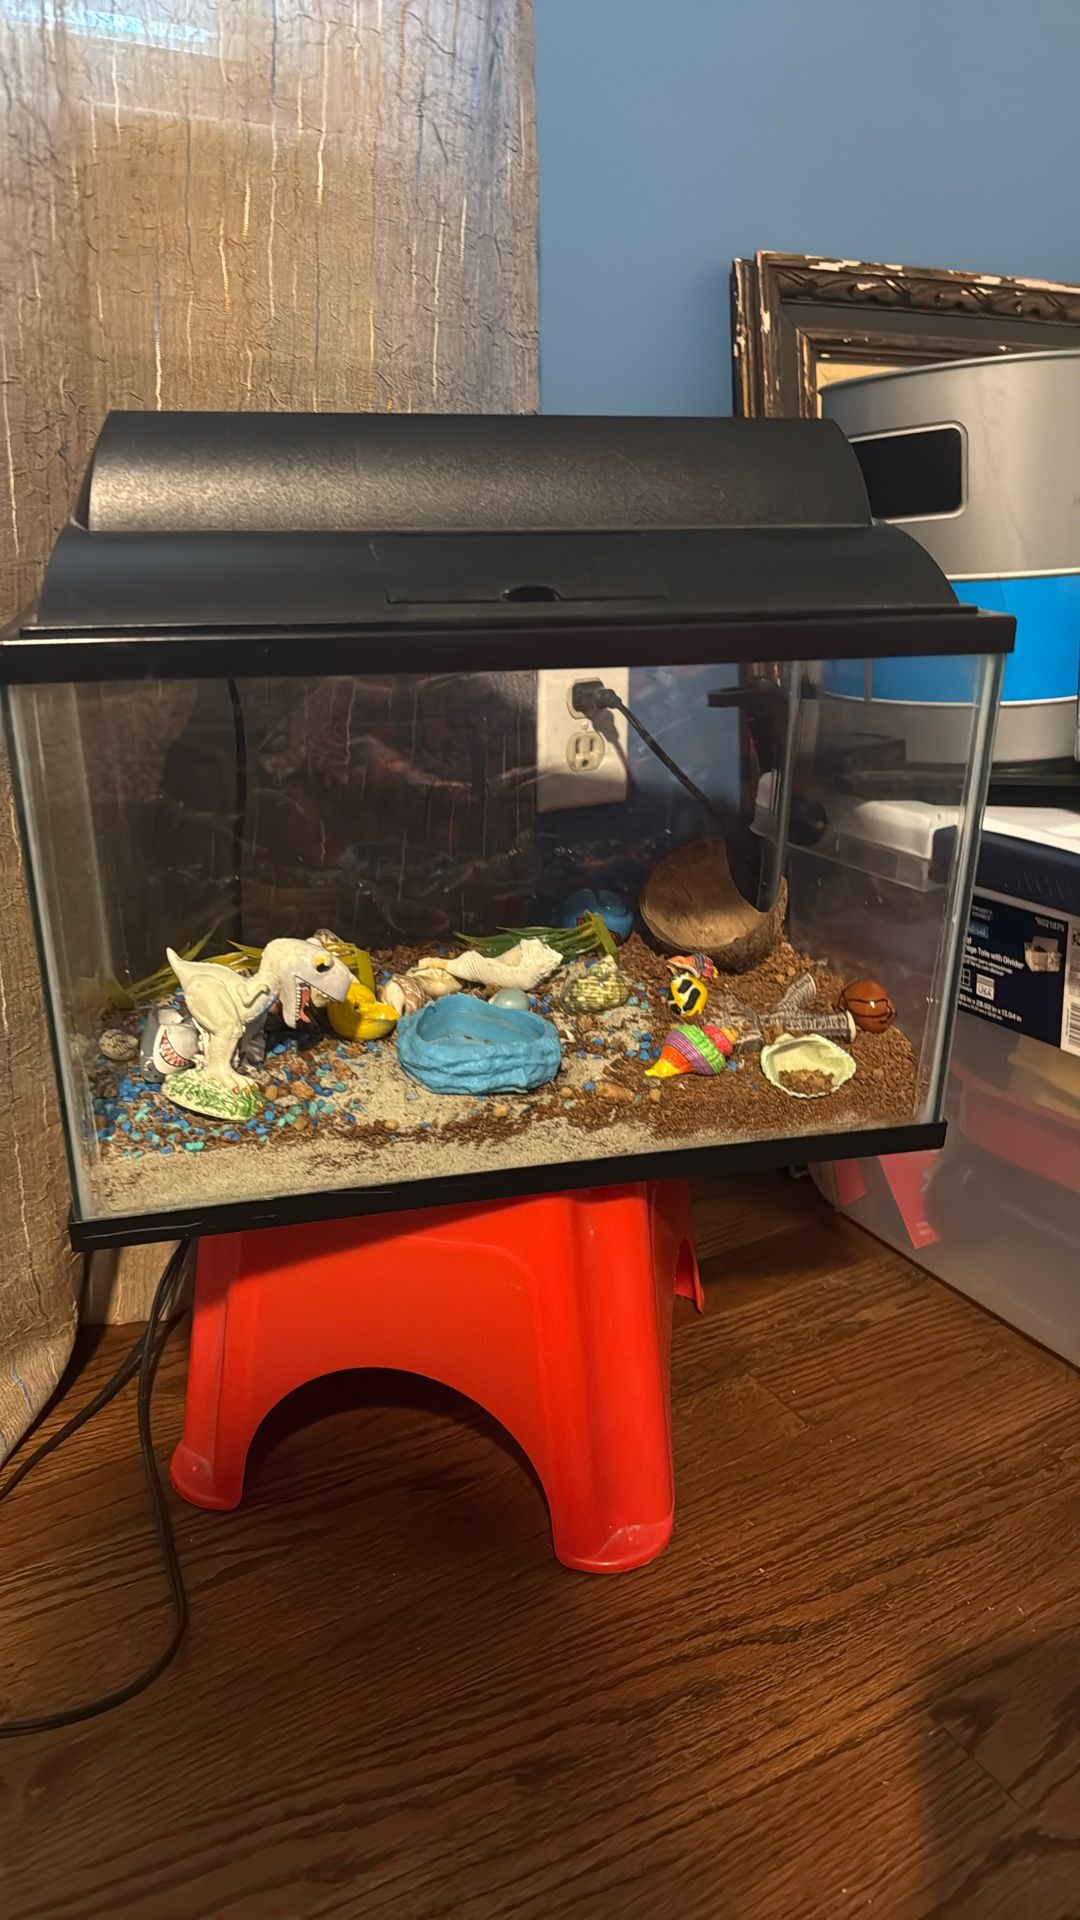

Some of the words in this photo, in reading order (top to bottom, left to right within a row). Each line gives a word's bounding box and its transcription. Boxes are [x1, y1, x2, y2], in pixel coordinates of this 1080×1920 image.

[978, 946, 991, 958] Tote
[991, 951, 1003, 962] with
[1003, 955, 1025, 969] Divider
